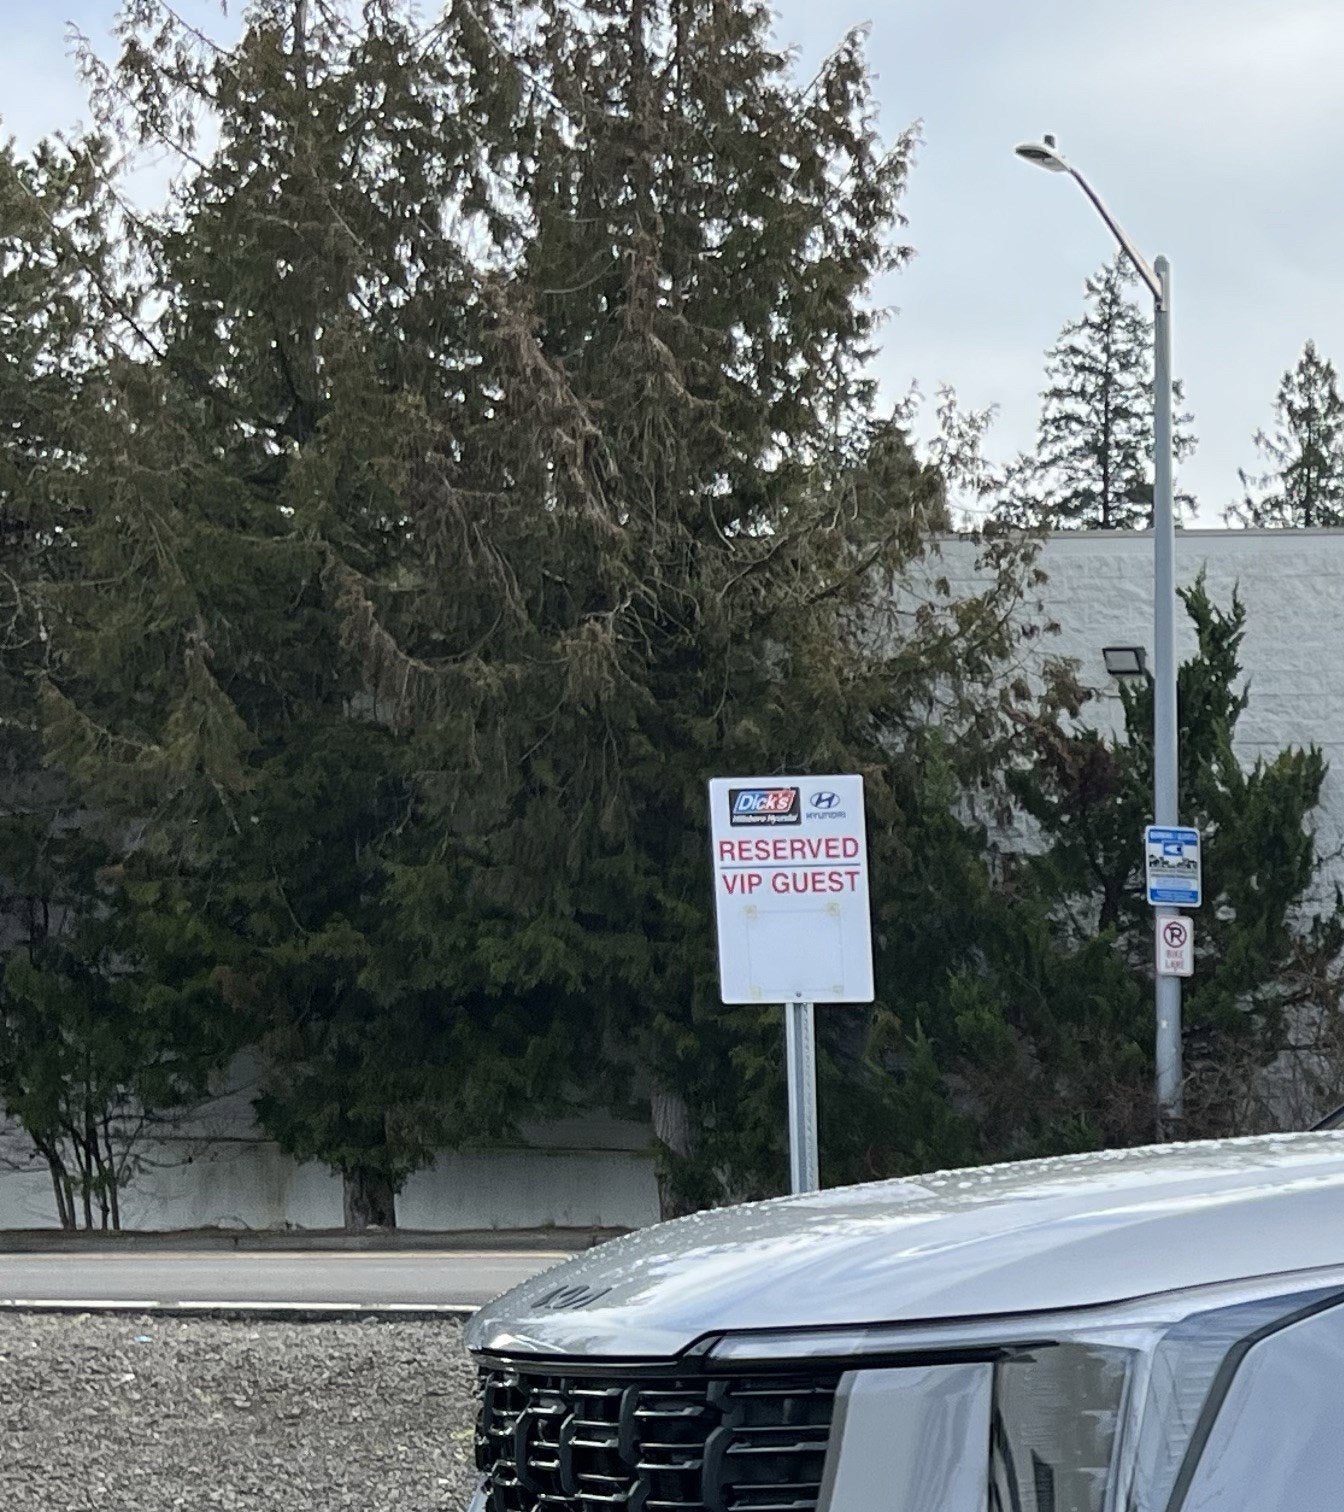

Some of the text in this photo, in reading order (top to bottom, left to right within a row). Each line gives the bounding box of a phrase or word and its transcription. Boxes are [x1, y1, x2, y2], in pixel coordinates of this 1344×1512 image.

[719, 837, 859, 861] RESERVED
[722, 871, 860, 894] VIP GUEST
